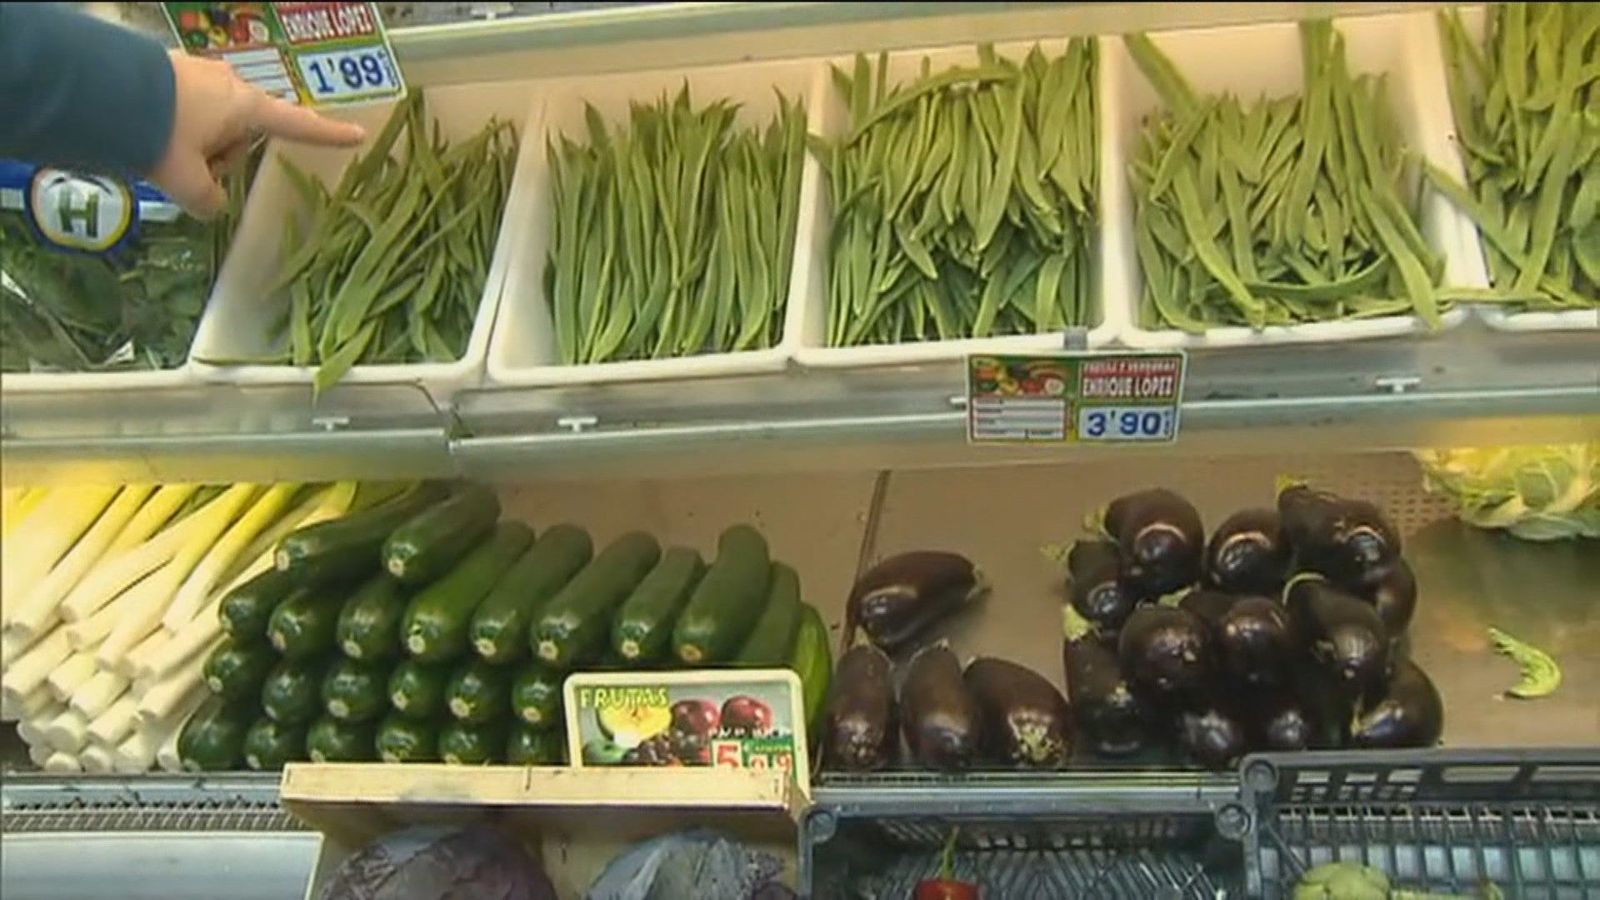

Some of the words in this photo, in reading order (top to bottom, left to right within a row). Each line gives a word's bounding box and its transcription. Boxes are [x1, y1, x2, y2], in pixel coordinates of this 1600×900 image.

[281, 10, 334, 41] ENRIQUE
[330, 4, 373, 36] LOPEZ
[309, 54, 384, 93] 1'99
[58, 188, 99, 238] H
[1083, 377, 1133, 397] ENRIQUE
[1135, 376, 1173, 397] LOPEZ
[1087, 410, 1162, 437] 3'90
[580, 687, 668, 709] FRUTAS
